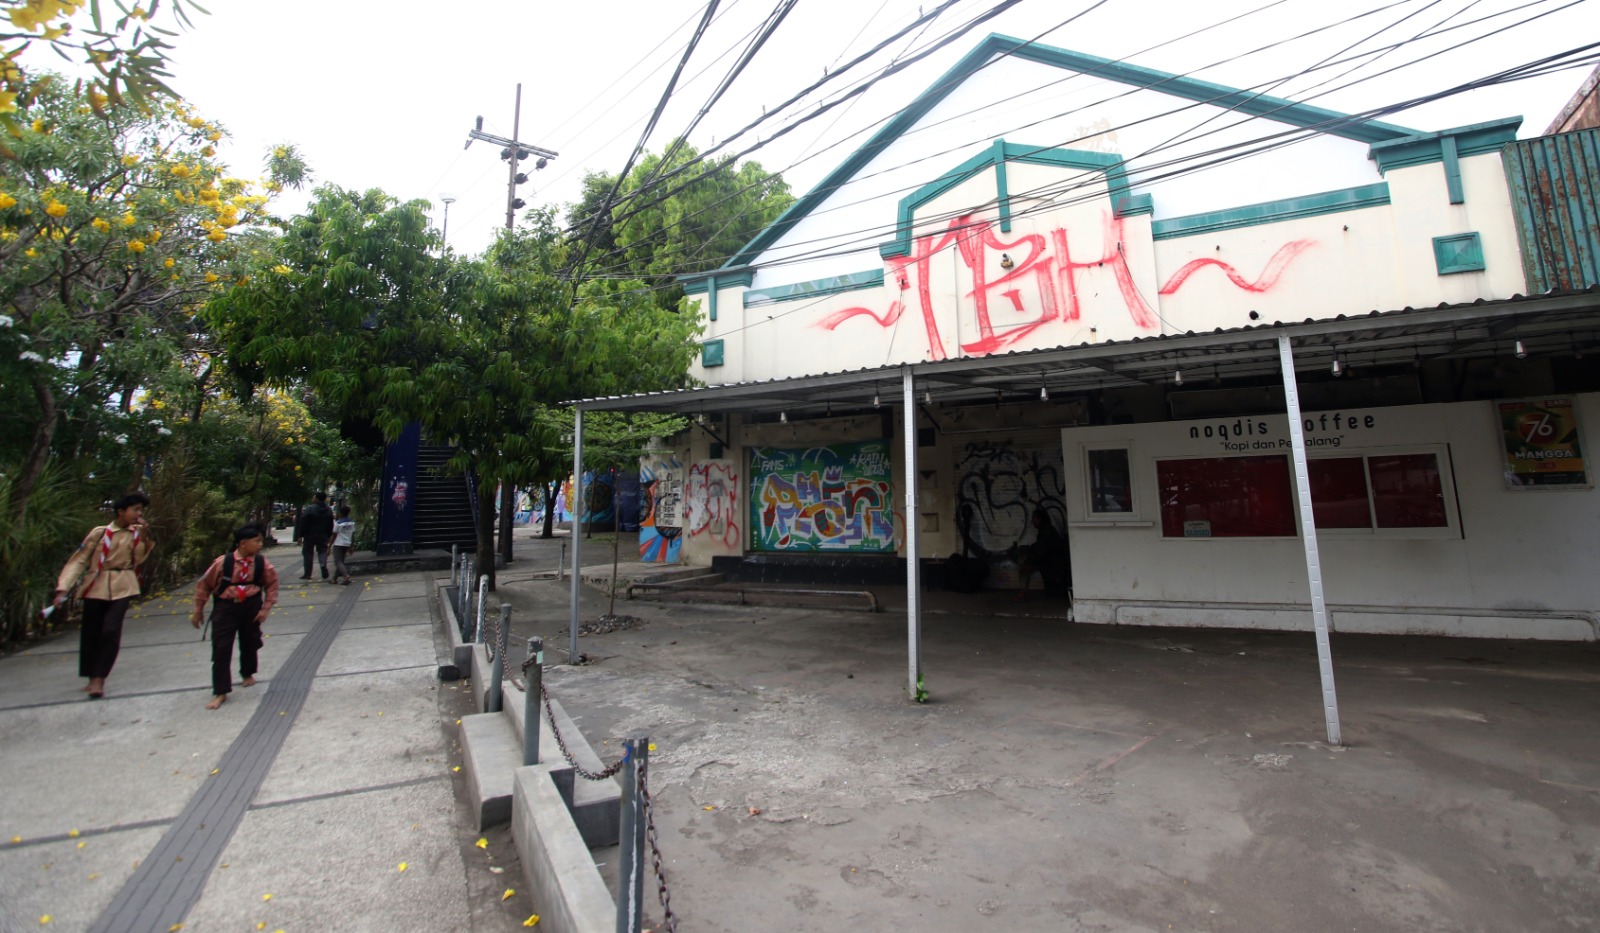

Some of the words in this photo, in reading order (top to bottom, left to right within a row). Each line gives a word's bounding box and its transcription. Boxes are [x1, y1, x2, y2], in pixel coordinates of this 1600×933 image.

[1190, 419, 1268, 441] noqdis
[1304, 413, 1375, 432] offee
[1526, 413, 1553, 443] 76
[1220, 441, 1249, 452] "Kopi
[1252, 440, 1276, 449] dan
[1515, 451, 1573, 460] MANGGA
